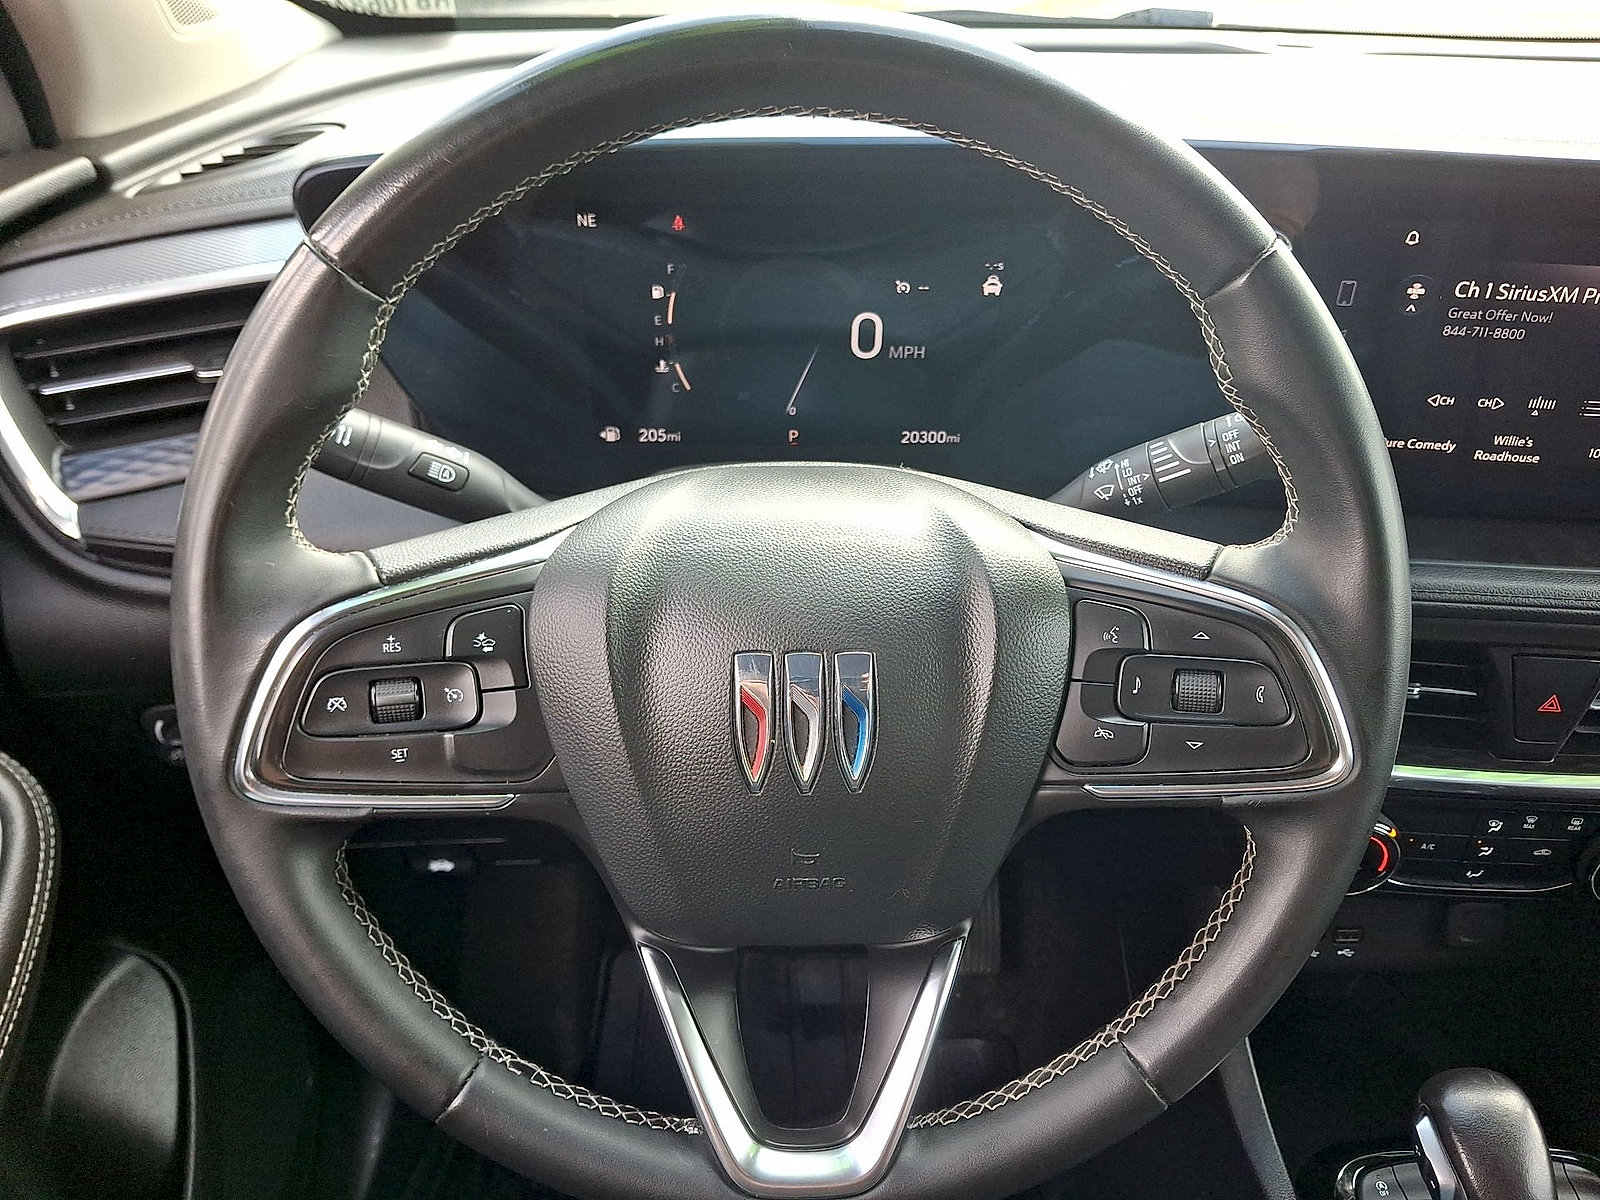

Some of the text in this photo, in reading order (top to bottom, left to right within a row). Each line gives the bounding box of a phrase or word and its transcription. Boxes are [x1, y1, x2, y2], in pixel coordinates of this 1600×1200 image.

[576, 213, 597, 228] NE
[667, 264, 675, 275] F
[1454, 280, 1480, 299] Ch
[1484, 282, 1494, 300] 1
[1495, 283, 1580, 304] SiriusXM
[654, 315, 662, 326] E
[1447, 307, 1554, 324] Great Offer Now!
[850, 311, 926, 360] 0 MPH
[1442, 325, 1526, 340] 844-711-8800
[655, 337, 664, 347] H
[1439, 396, 1456, 406] CH
[1477, 398, 1493, 408] CH
[788, 429, 799, 442] P
[1221, 429, 1240, 442] OFF
[1493, 435, 1534, 448] Willie's
[1224, 440, 1241, 454] INT
[1384, 437, 1457, 452] ure Comedy
[1229, 452, 1245, 465] ON
[1473, 450, 1541, 464] Roadhouse
[1120, 459, 1130, 469] HI
[1121, 468, 1133, 478] LO
[1127, 474, 1141, 486] INT
[1127, 484, 1144, 497] OFF
[1131, 496, 1144, 506] 1x
[382, 642, 402, 653] RES
[390, 747, 409, 760] SET
[1421, 842, 1437, 851] A/C
